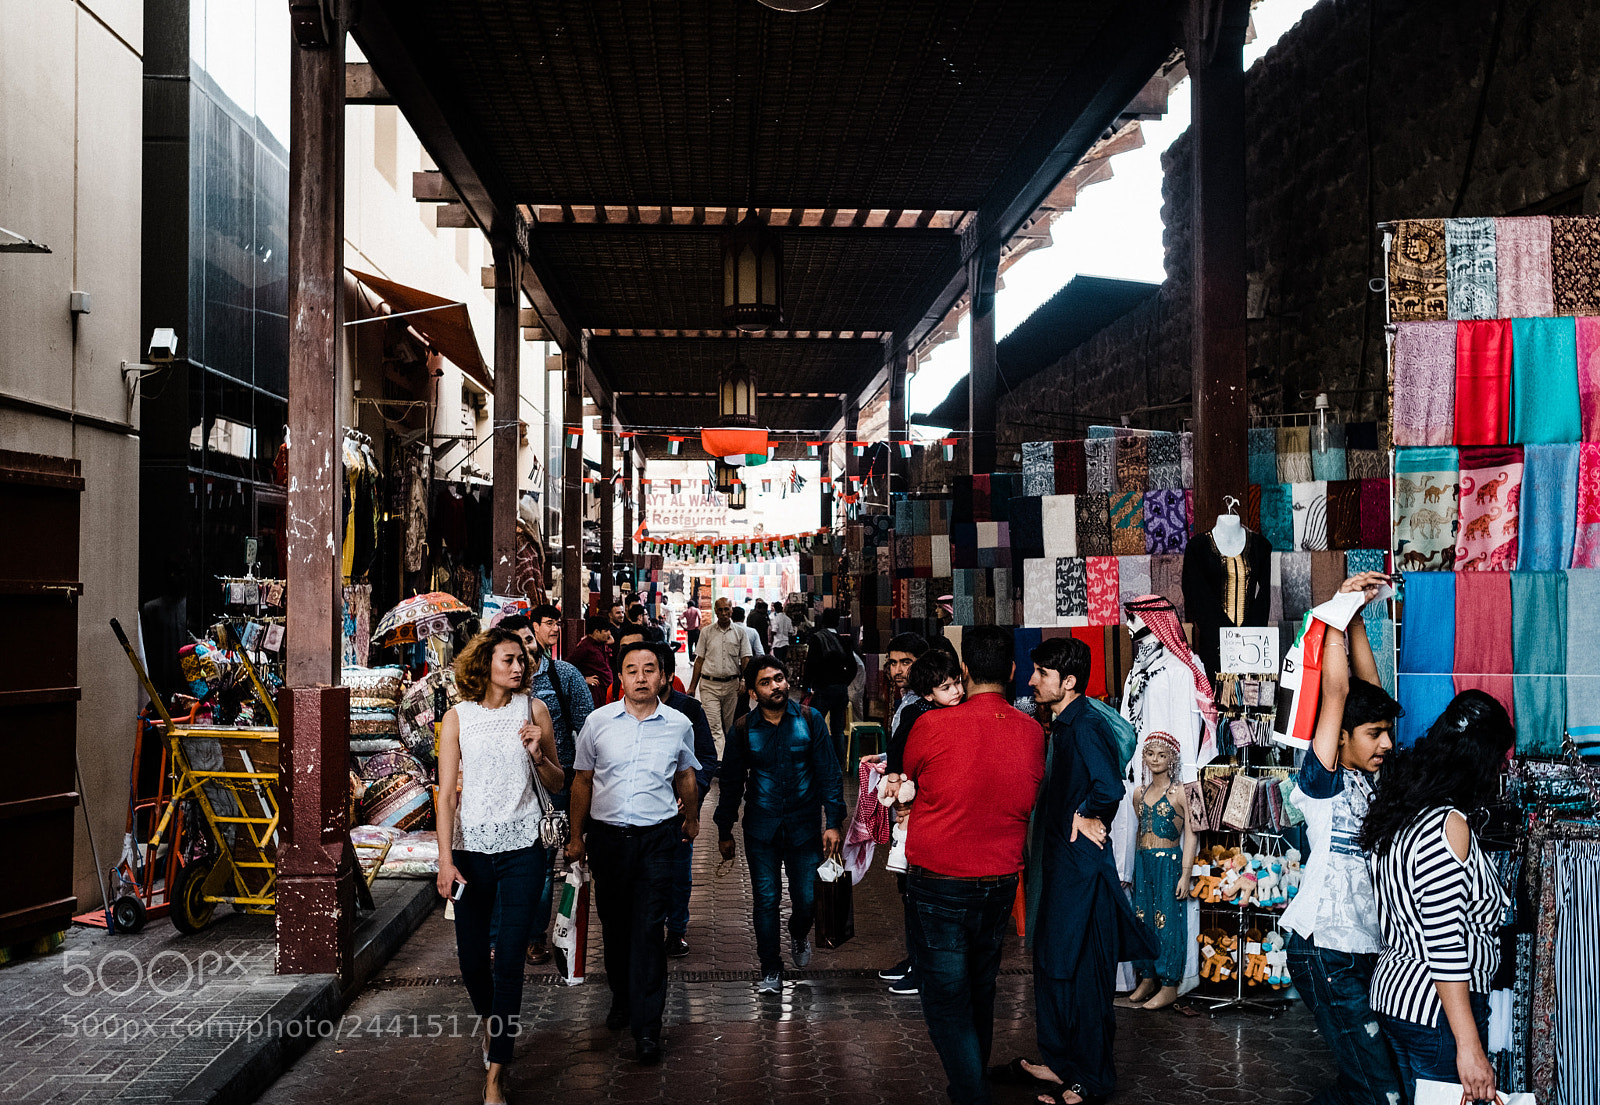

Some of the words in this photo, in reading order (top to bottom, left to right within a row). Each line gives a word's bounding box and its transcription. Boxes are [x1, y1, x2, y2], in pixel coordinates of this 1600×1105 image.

[670, 494, 686, 507] AL
[652, 513, 727, 526] Restaurant
[1238, 634, 1262, 665] 5
